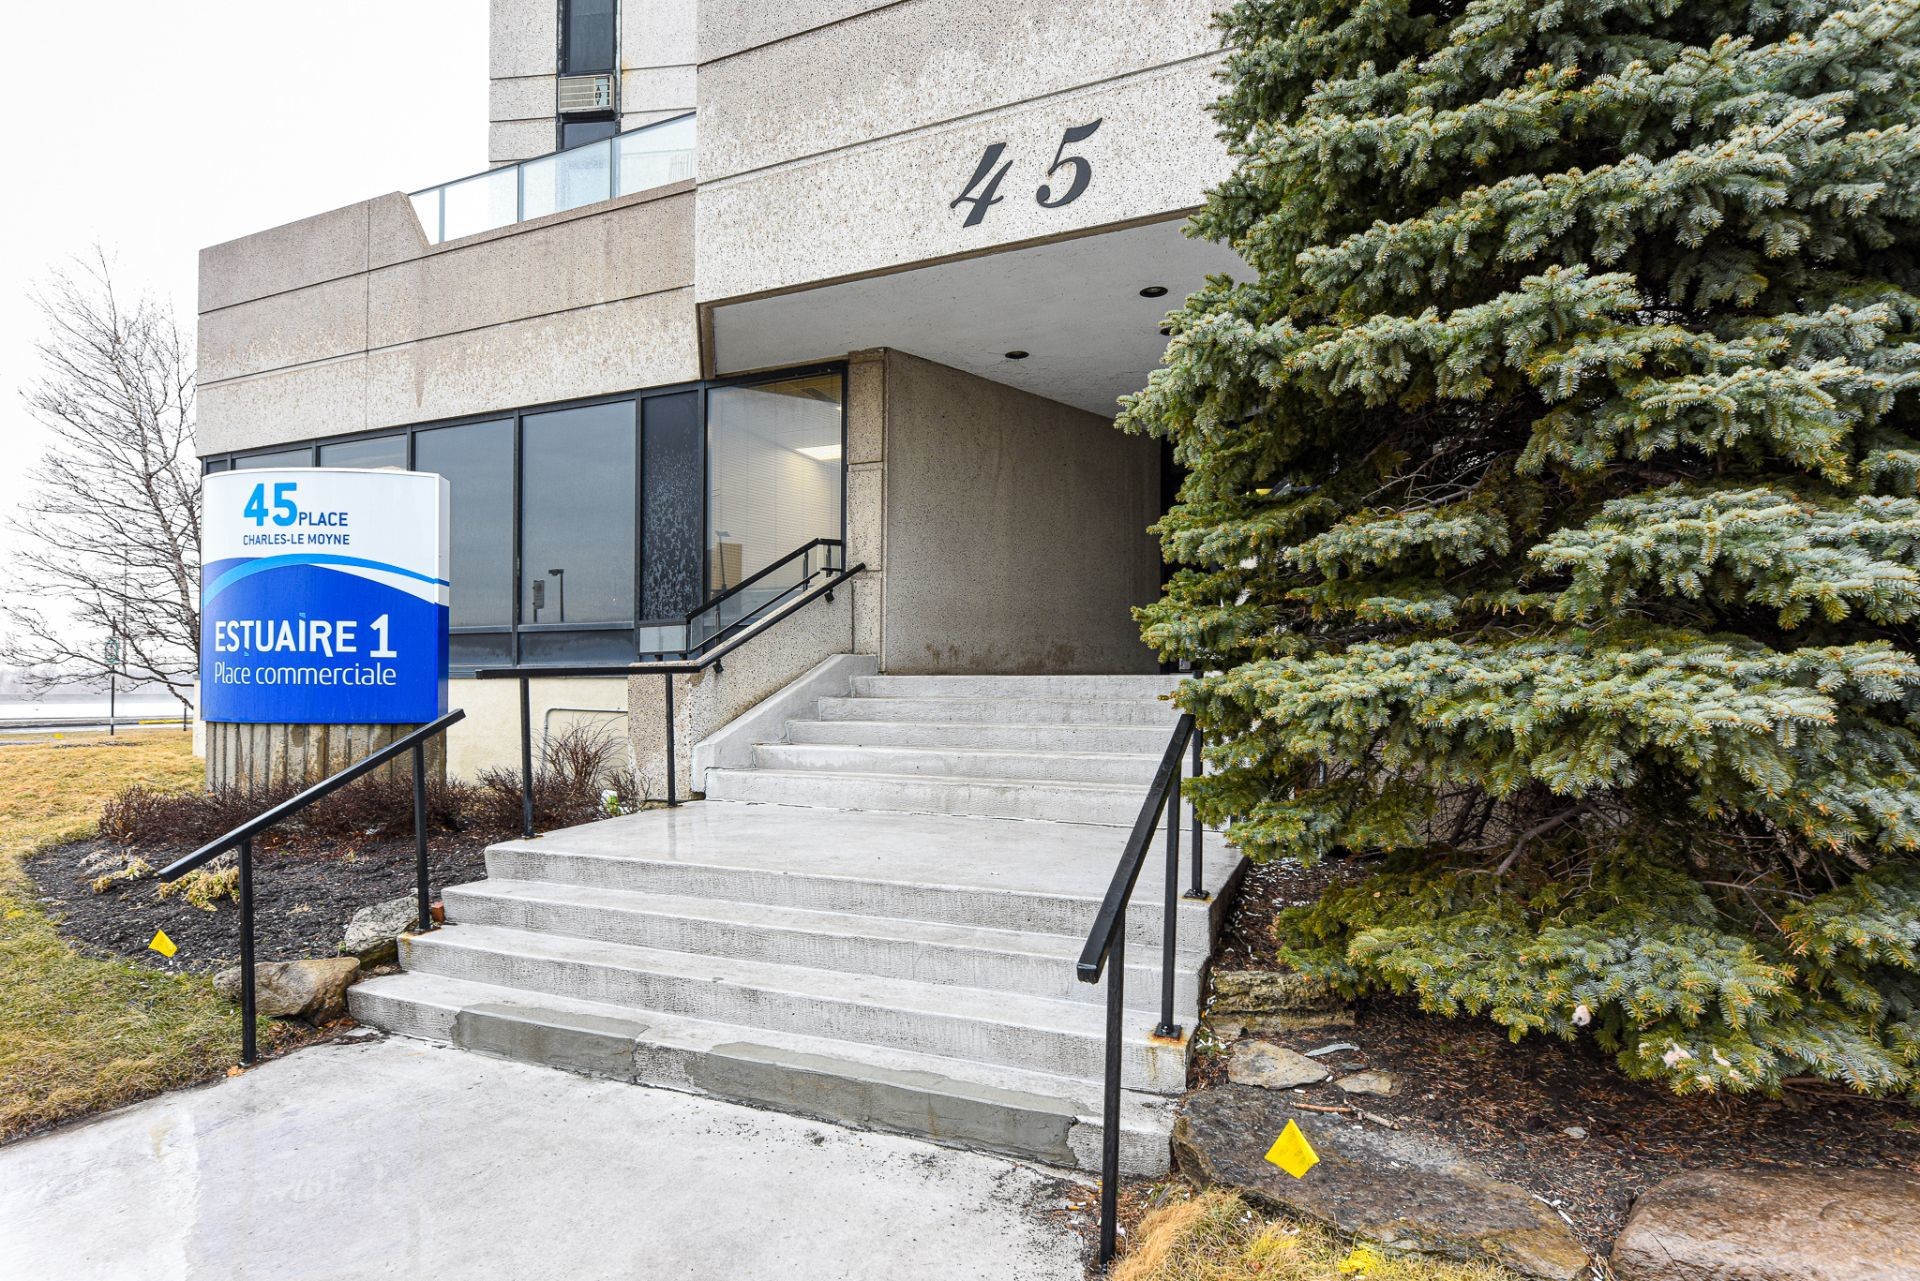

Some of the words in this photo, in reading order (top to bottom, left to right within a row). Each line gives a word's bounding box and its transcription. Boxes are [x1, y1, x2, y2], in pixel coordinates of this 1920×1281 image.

[950, 117, 1103, 228] 45
[243, 482, 298, 527] 45
[298, 511, 349, 527] PLACE
[243, 533, 305, 546] CHARLES-LE
[307, 533, 350, 545] MOYNE
[369, 613, 398, 658] 1
[214, 661, 251, 685] Place
[255, 662, 397, 686] commerciale
